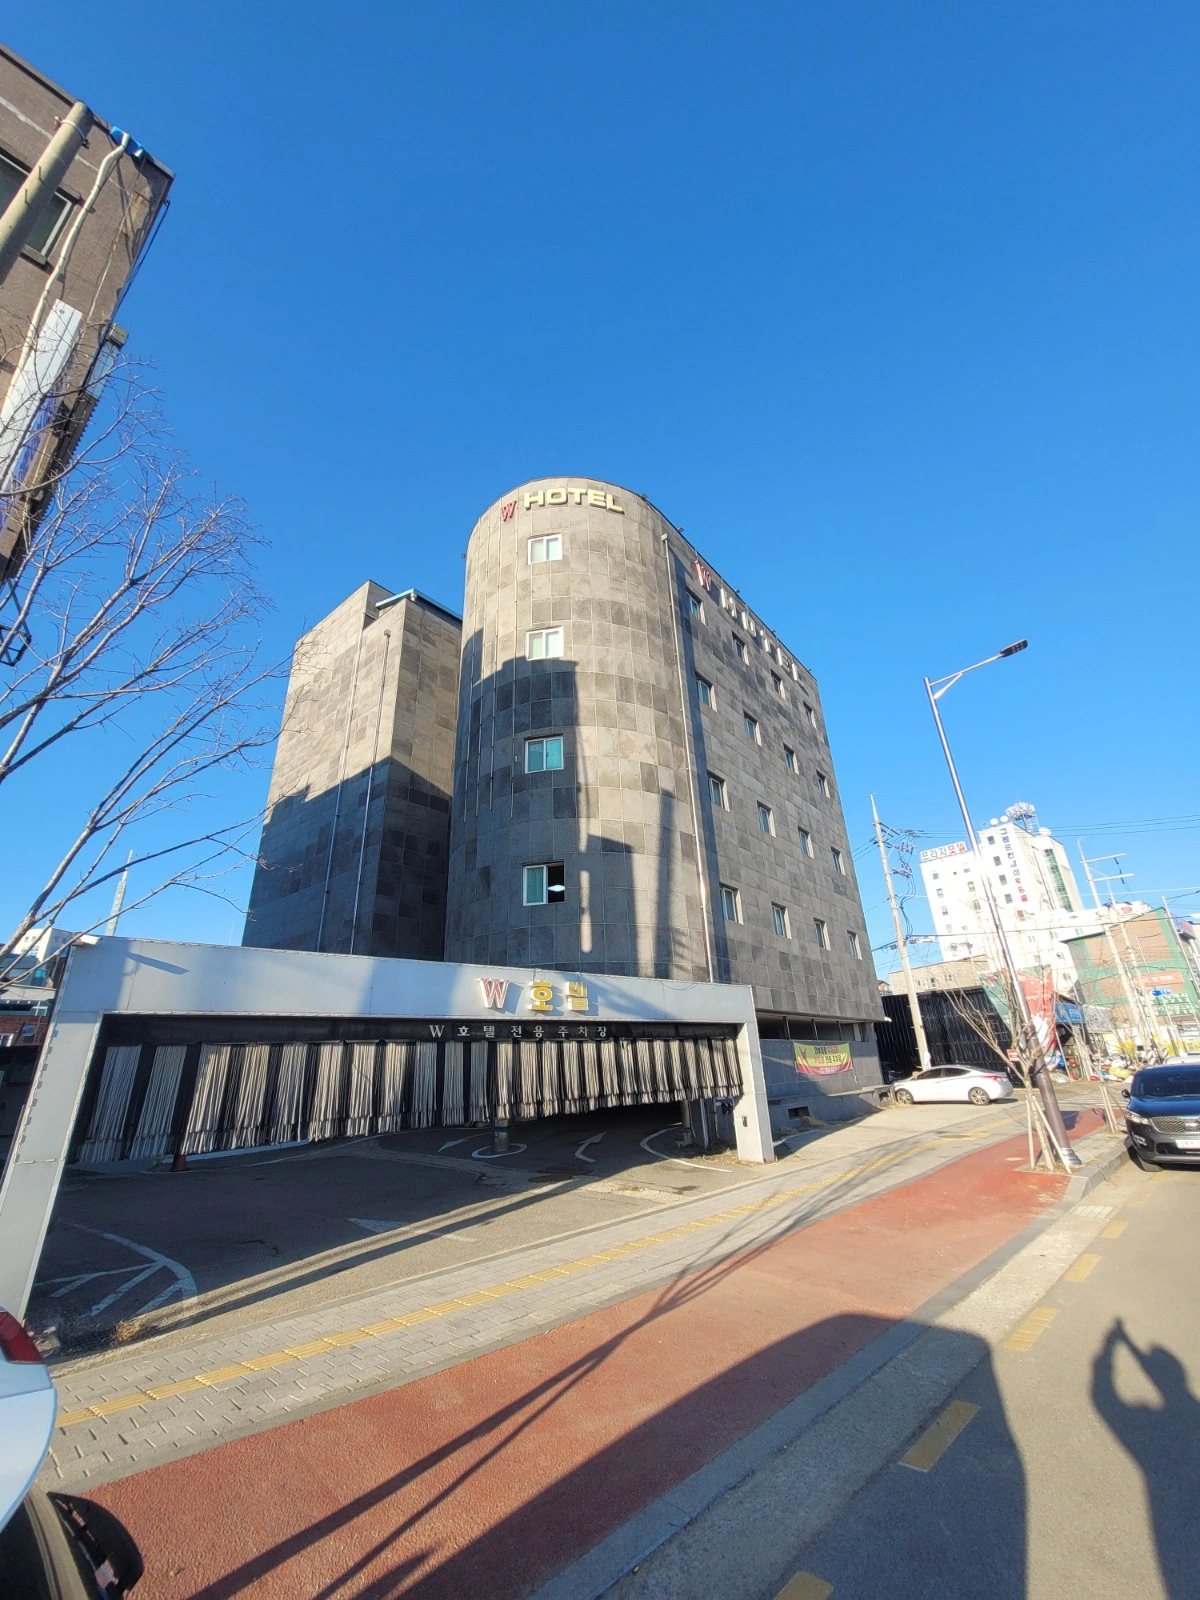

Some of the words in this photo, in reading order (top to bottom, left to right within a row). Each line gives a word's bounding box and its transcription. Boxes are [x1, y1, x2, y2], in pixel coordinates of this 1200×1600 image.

[500, 499, 518, 522] W
[523, 487, 625, 515] HOTEL
[694, 560, 712, 591] W
[478, 977, 511, 1009] W
[429, 1024, 446, 1038] W
[456, 1025, 496, 1038] 호텔
[510, 1025, 545, 1038] 전용
[557, 1025, 608, 1038] 주차장
